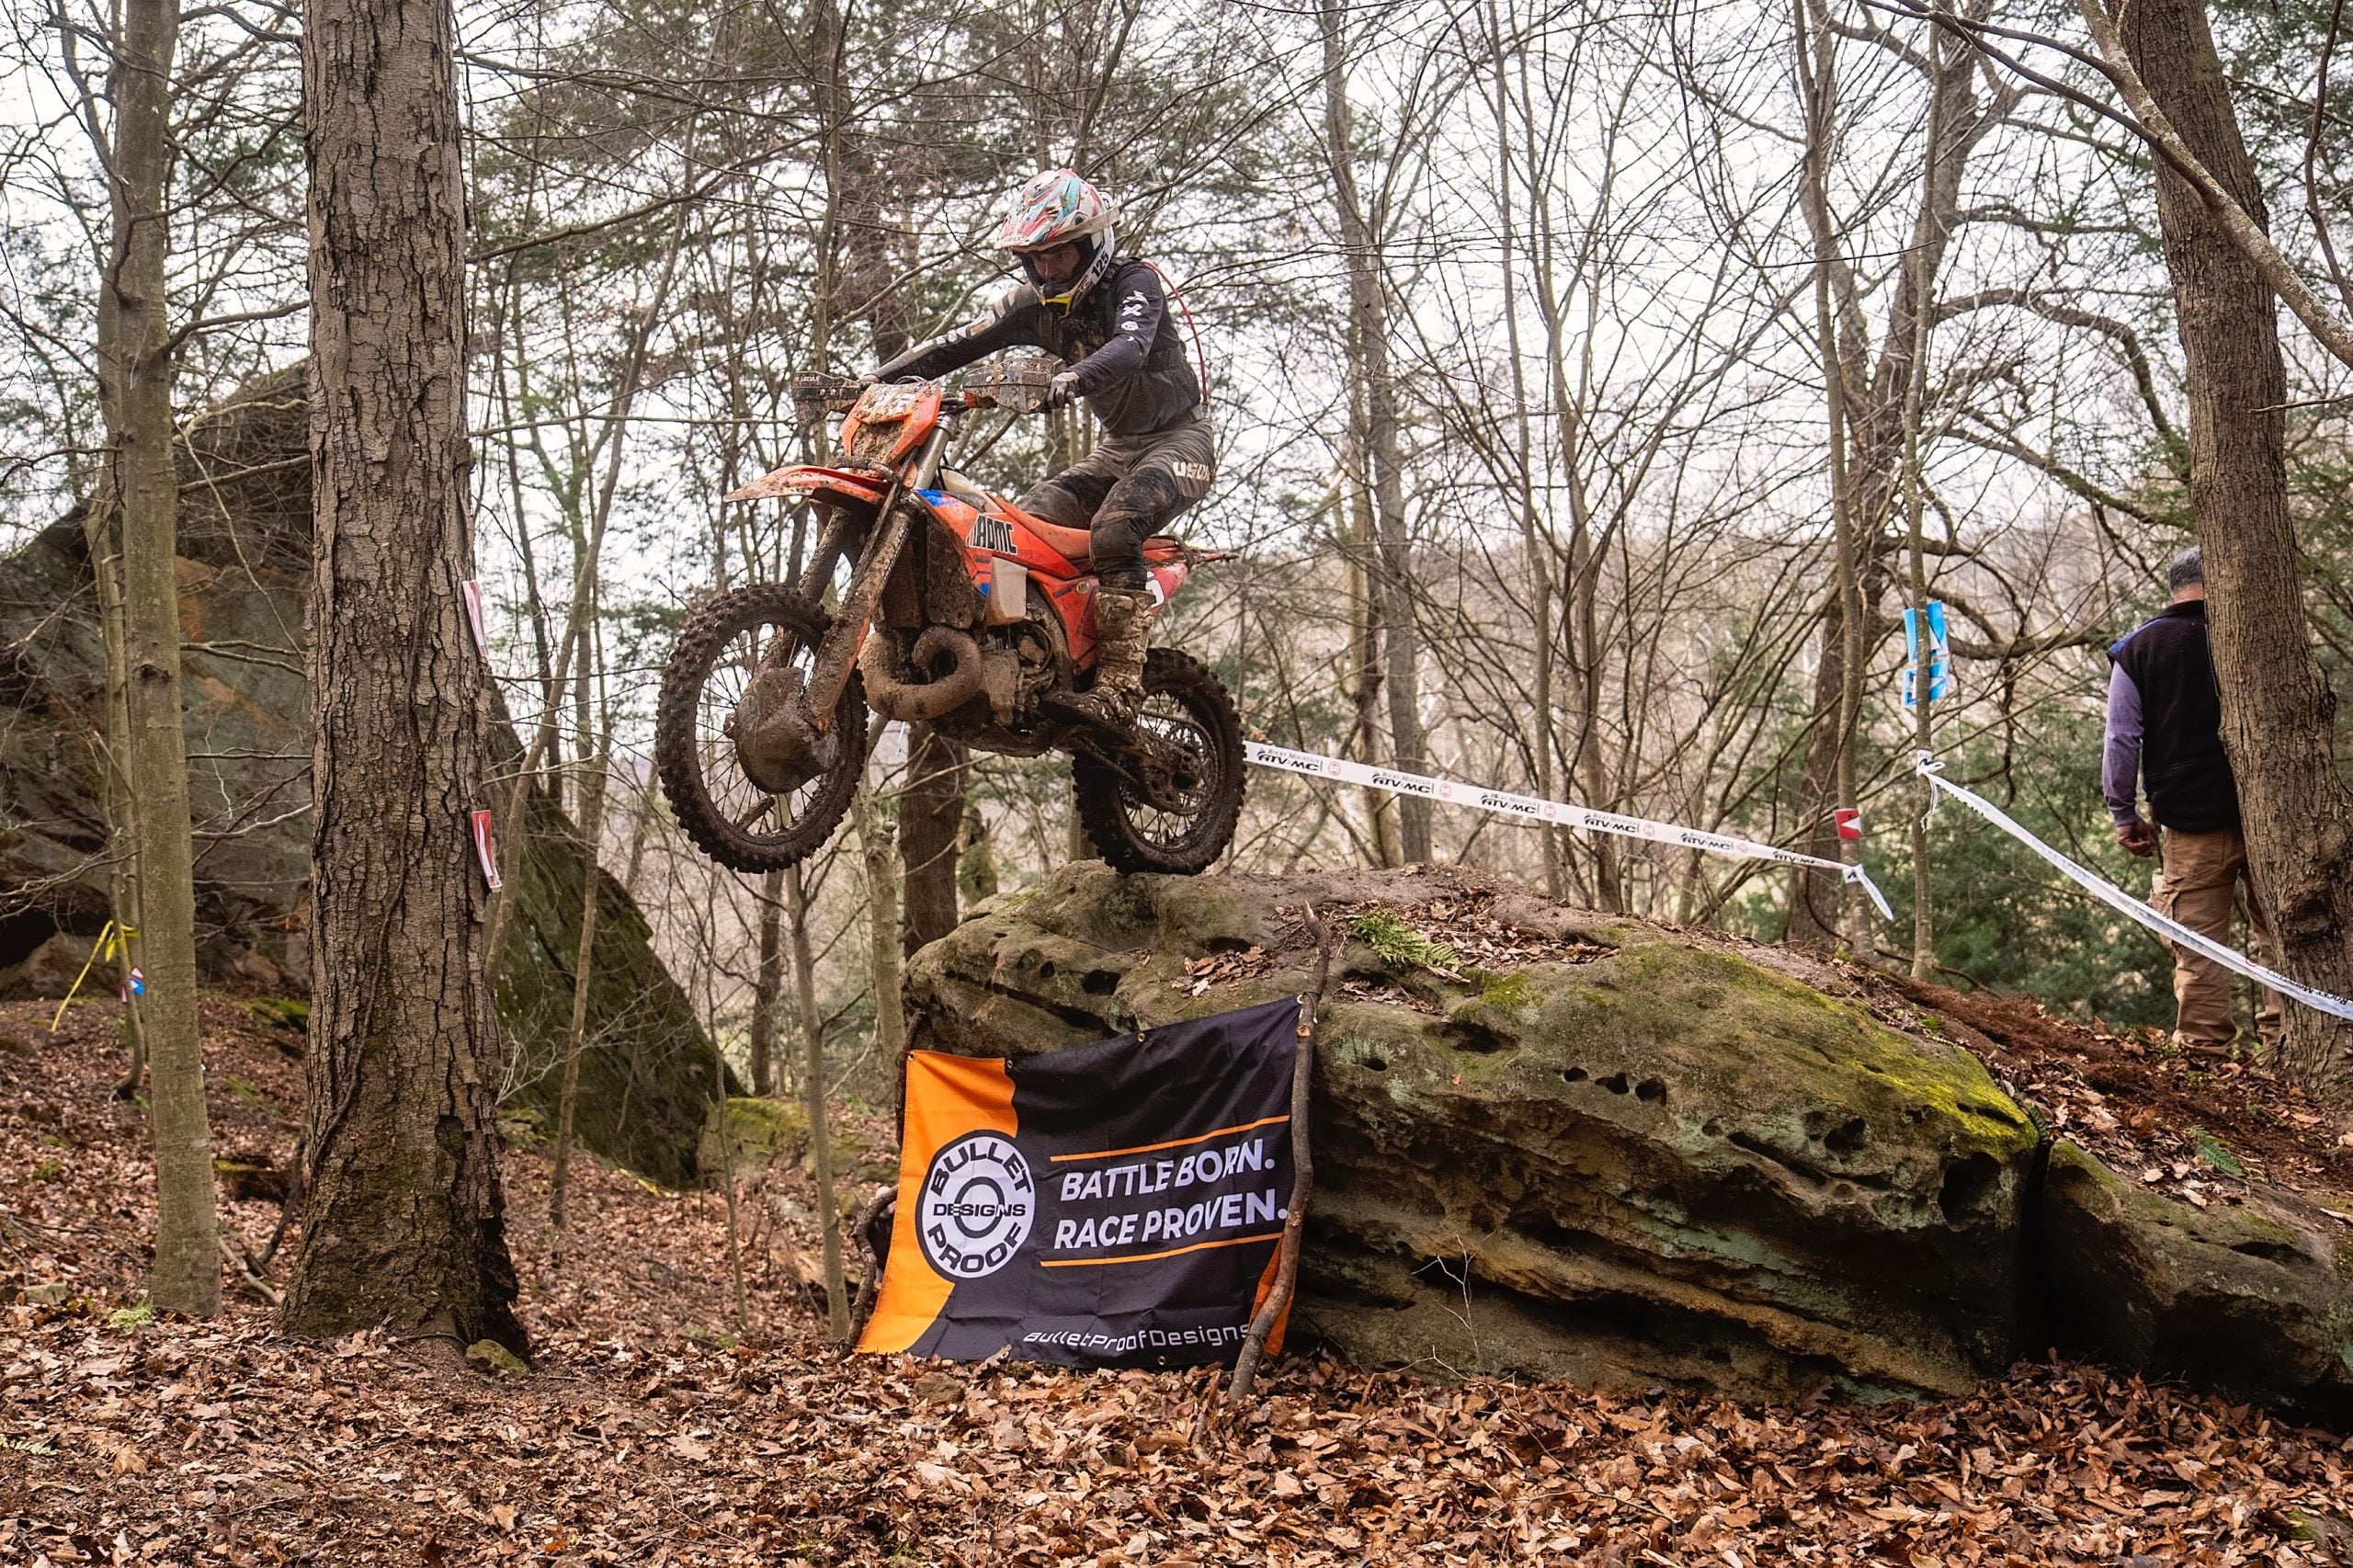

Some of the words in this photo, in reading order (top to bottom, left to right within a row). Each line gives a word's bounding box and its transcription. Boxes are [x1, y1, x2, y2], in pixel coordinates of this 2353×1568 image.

[1091, 250, 1109, 278] 125
[930, 1142, 1032, 1197] BULLET
[1060, 1160, 1175, 1201] BATTLE
[1174, 1139, 1276, 1187] BORN.
[933, 1204, 1026, 1217] DESIGNS
[1053, 1214, 1140, 1250] RACE
[1142, 1188, 1288, 1242] PROVEN.
[927, 1221, 1022, 1273] PROOF
